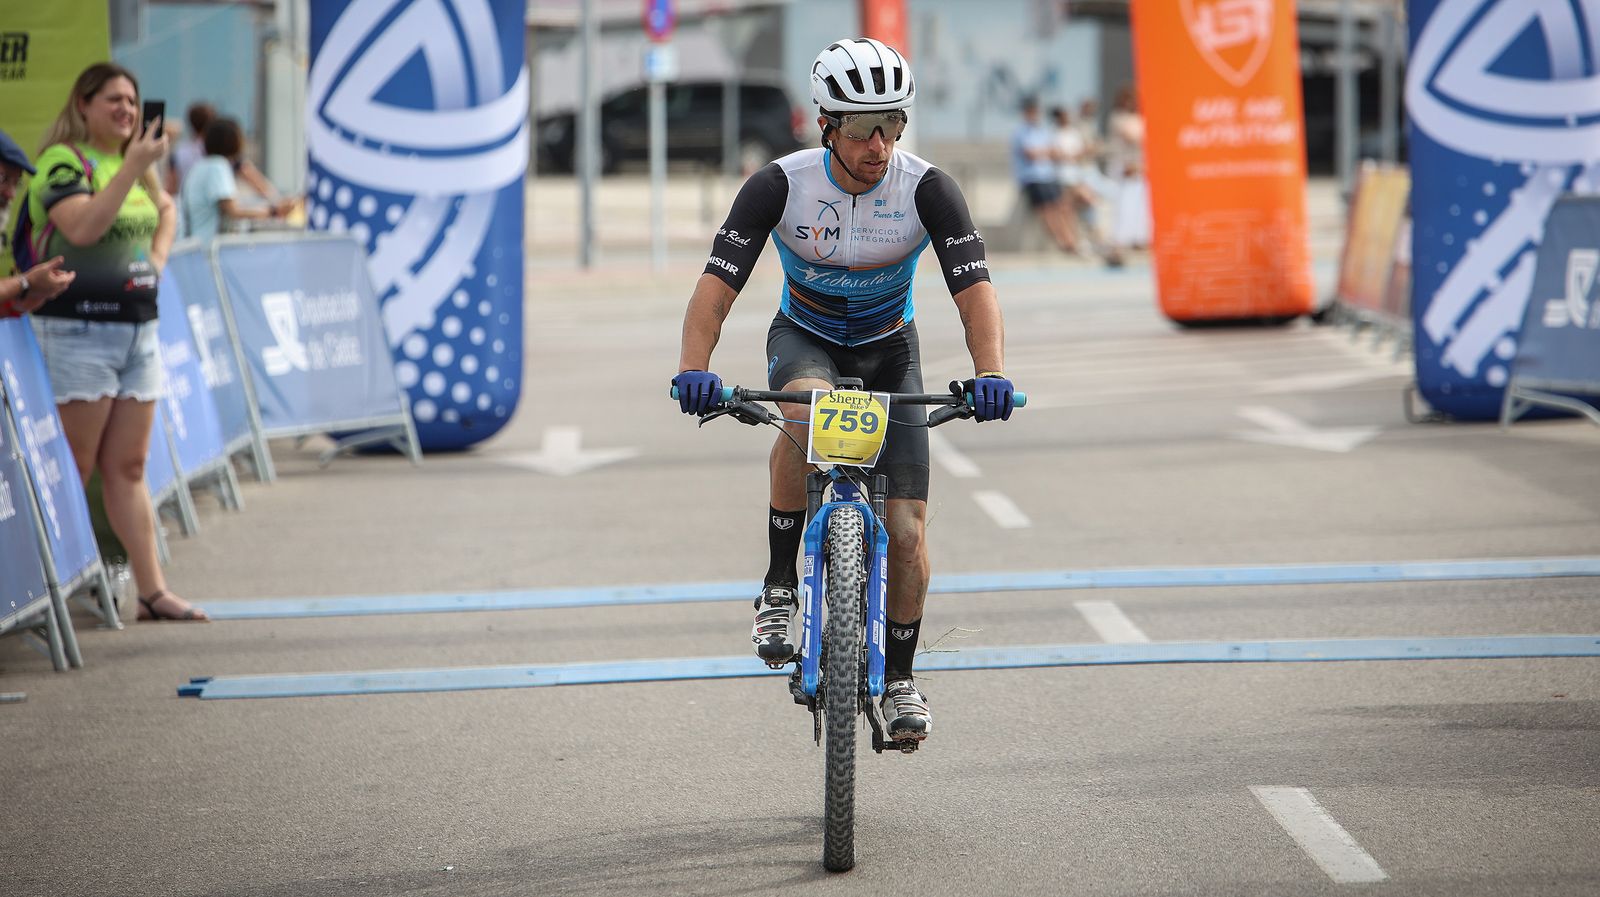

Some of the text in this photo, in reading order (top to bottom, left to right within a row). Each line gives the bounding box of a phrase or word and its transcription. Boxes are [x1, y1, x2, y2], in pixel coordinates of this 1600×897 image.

[873, 211, 893, 219] Puerto
[726, 230, 751, 246] Real
[795, 226, 899, 241] SYM SERVICIOS
[850, 235, 907, 244] INTEGRALES
[945, 233, 975, 249] Puerto
[829, 393, 872, 409] Sherry
[819, 408, 879, 435] 759
